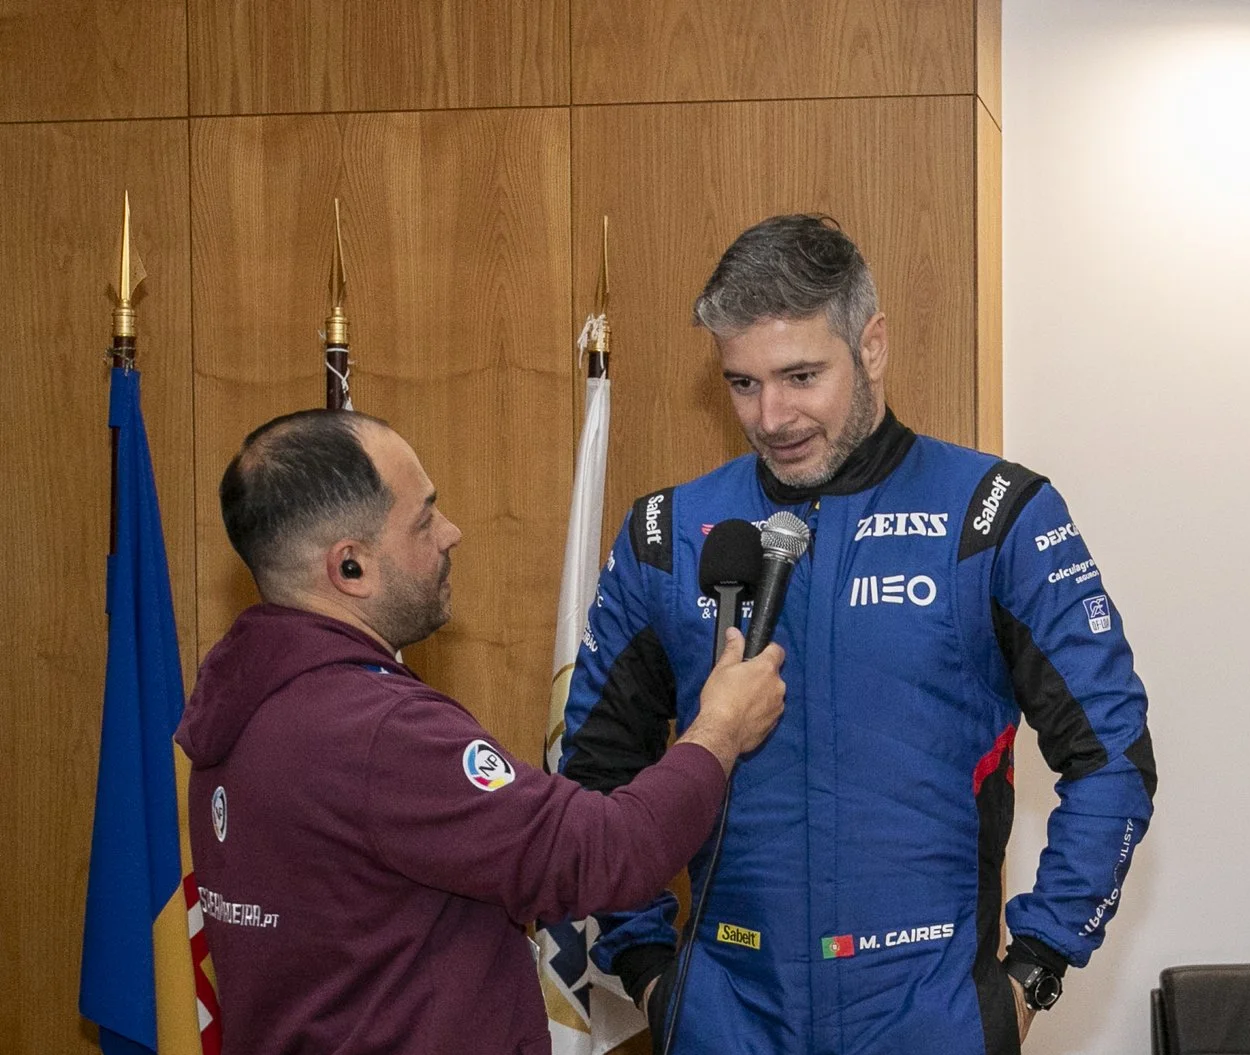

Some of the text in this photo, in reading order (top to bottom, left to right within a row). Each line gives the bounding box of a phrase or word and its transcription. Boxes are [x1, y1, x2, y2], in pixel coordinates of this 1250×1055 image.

[973, 473, 1011, 535] Sabelt
[645, 494, 663, 545] Sabelt
[854, 513, 948, 541] ZEISS
[850, 575, 936, 607] MEO
[478, 754, 498, 777] NP
[721, 925, 757, 947] Sabelt
[859, 923, 955, 950] M. CAIRES
